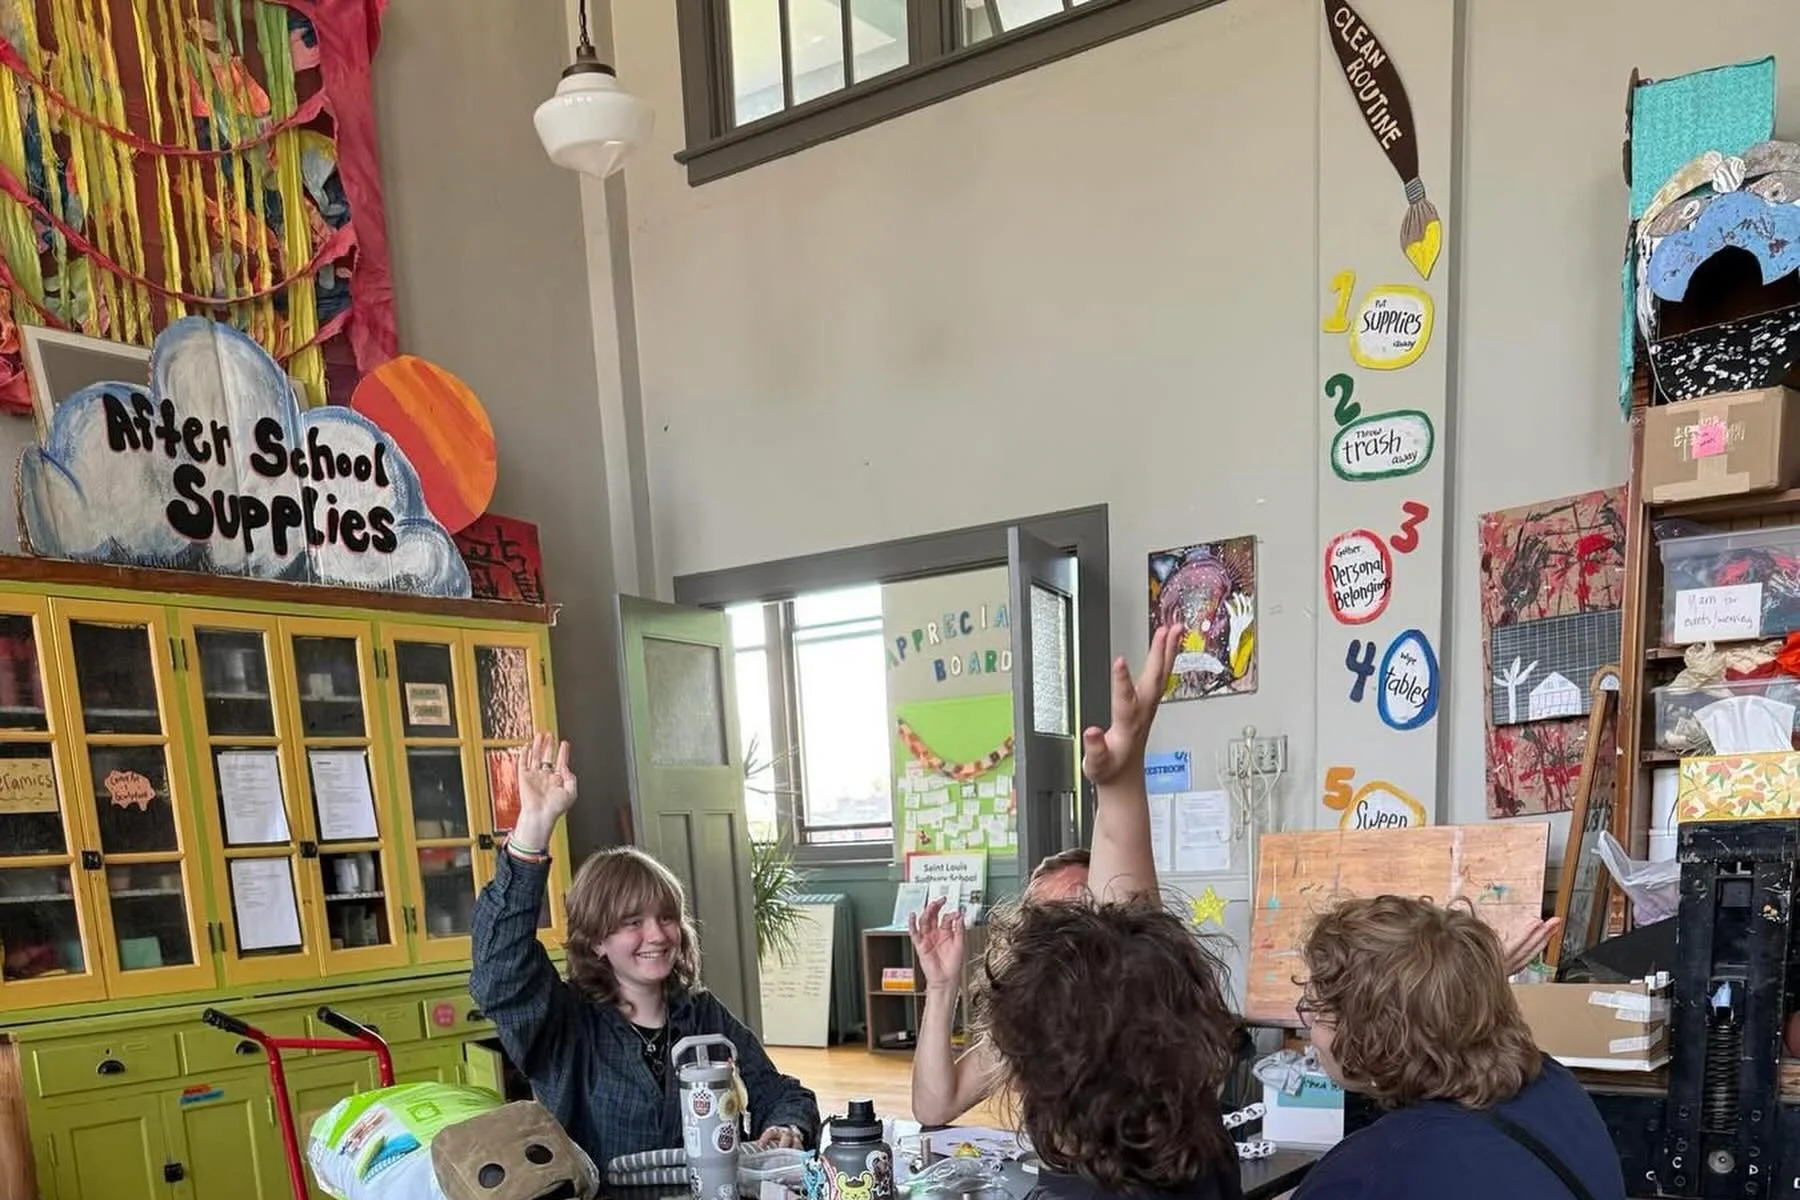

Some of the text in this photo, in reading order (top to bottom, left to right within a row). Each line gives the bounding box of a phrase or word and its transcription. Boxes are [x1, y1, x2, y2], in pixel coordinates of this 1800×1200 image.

[1334, 7, 1386, 68] CLEAN
[1346, 57, 1402, 150] ROUTINE
[1322, 269, 1356, 333] 1
[1325, 373, 1361, 427] 2
[103, 394, 388, 488] After School
[1342, 428, 1402, 464] trash
[1391, 450, 1418, 465] away
[166, 464, 398, 556] Supplies
[1390, 501, 1429, 554] 3
[1330, 551, 1384, 588] Personal
[932, 650, 1012, 682] BOARD
[1345, 639, 1377, 703] 4
[1384, 666, 1428, 708] tables
[0, 773, 53, 791] ramics
[1145, 764, 1185, 776] ESTROOM
[1322, 766, 1355, 811] 5
[923, 862, 967, 872] Saint Louis
